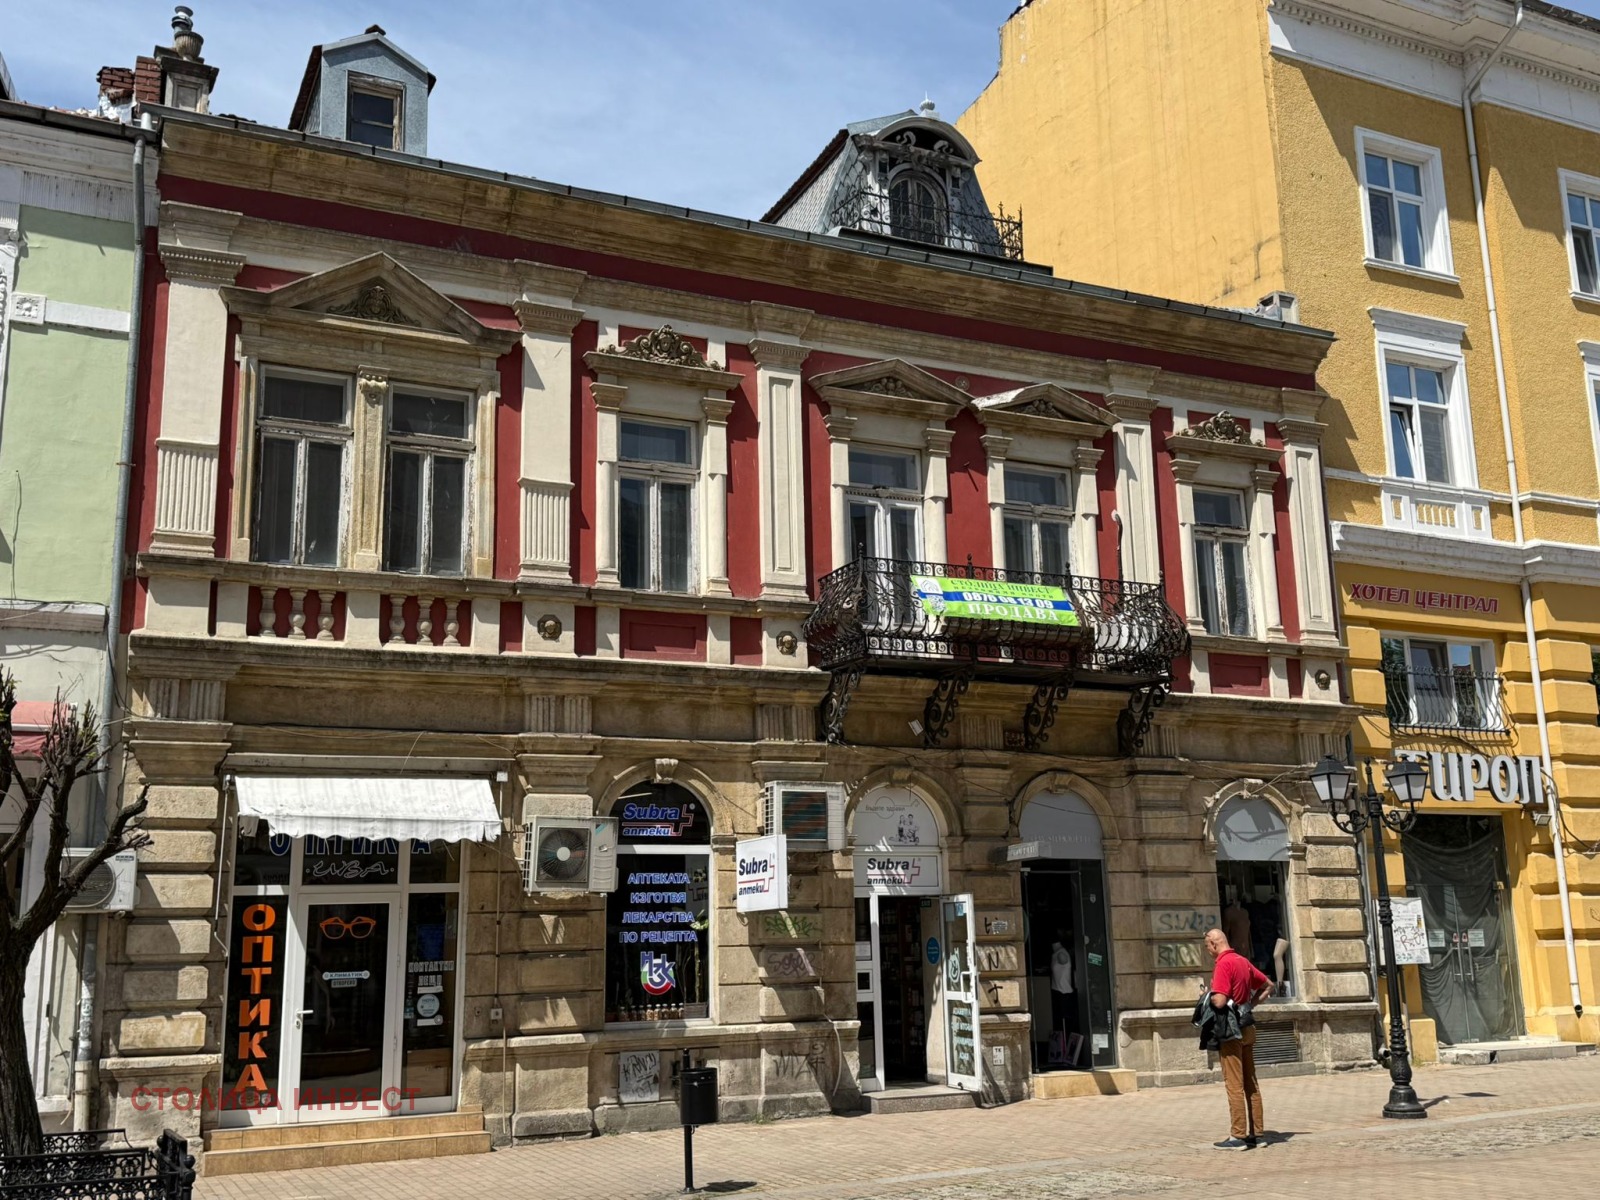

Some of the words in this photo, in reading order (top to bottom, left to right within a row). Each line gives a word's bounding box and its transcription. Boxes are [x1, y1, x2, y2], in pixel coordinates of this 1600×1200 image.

[1350, 583, 1410, 604] ХОТЕЛ
[1415, 590, 1499, 613] ЦЕНТРАЛ
[967, 603, 1059, 621] ПРОДАВА
[623, 803, 680, 819] Subra
[739, 857, 768, 876] Subra
[867, 858, 910, 871] Subra
[627, 872, 691, 885] АПТЕКАТА
[630, 892, 686, 904] ИЗГОТВЯ
[622, 911, 696, 923] ЛЕКАРСТВА
[619, 931, 638, 943] ПО
[640, 930, 698, 944] РЕЦЕПТА
[235, 903, 276, 1092] ОПТИКА
